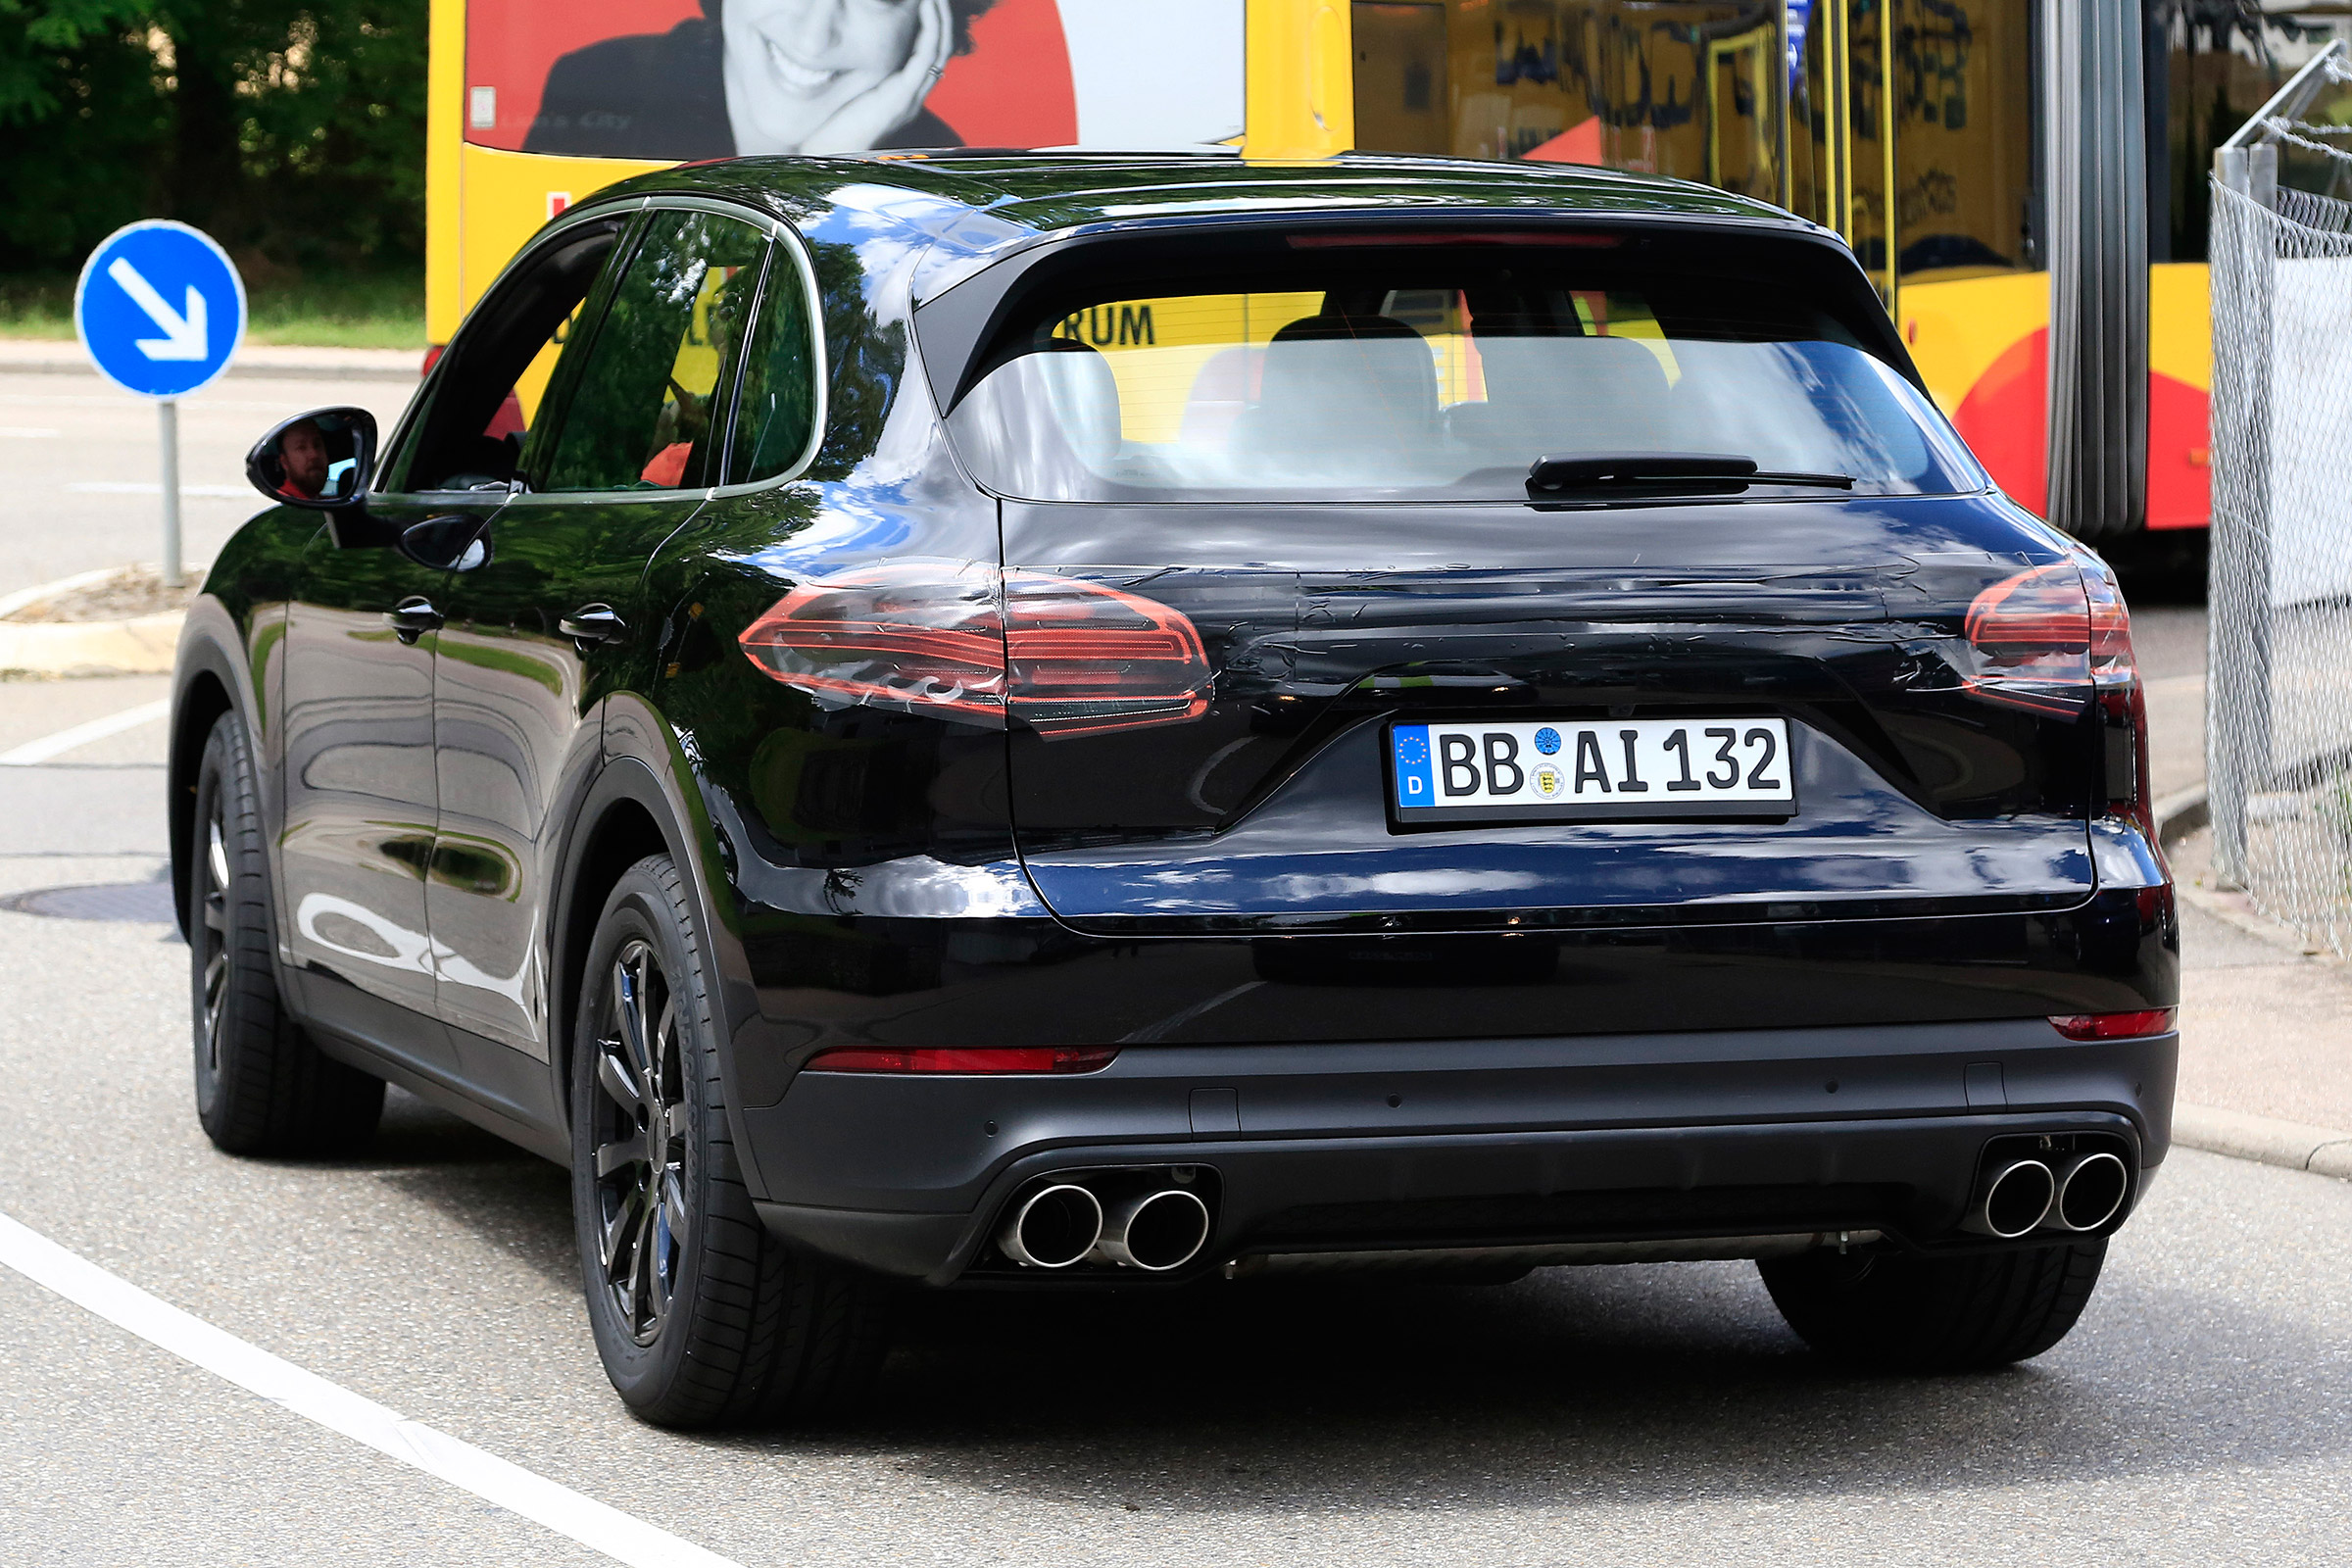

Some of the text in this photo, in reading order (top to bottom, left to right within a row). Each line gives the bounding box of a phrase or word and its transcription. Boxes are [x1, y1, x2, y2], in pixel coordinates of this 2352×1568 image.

[1439, 732, 1524, 797] BB
[1574, 729, 1649, 794] AI
[1663, 727, 1782, 792] 132
[1407, 775, 1423, 795] D
